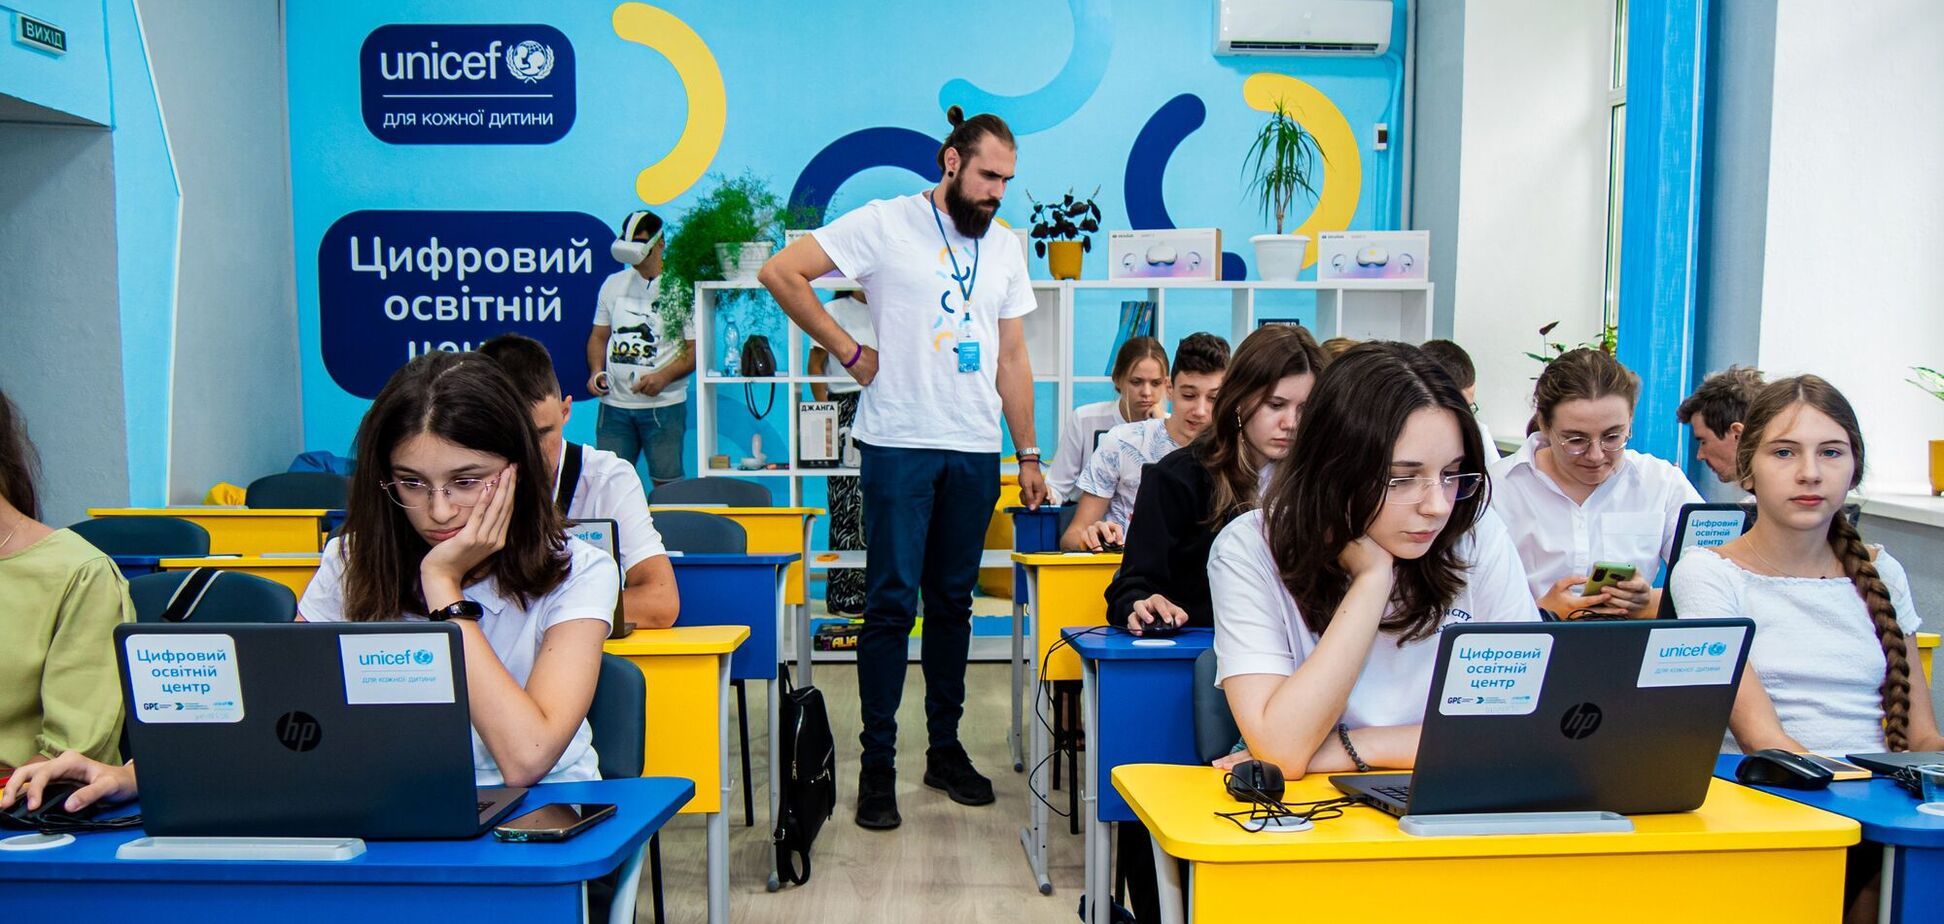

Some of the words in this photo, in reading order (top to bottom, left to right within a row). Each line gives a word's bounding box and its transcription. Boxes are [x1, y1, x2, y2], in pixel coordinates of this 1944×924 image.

[26, 21, 63, 49] ВИХІД
[381, 41, 502, 80] unicef
[383, 112, 416, 128] для
[422, 109, 484, 126] кожної
[489, 112, 554, 128] дитини
[351, 236, 592, 281] Цифровий
[384, 286, 562, 322] освітній
[801, 404, 835, 412] ДЖАНГА
[1692, 519, 1738, 527] Цифровий
[1451, 608, 1472, 621] CITY
[137, 649, 227, 664] Цифровий
[359, 649, 411, 666] unicef
[1459, 647, 1541, 661] Цифровий
[1659, 642, 1709, 658] unicef
[151, 665, 217, 677] освітній
[1466, 662, 1527, 674] освітній
[162, 683, 211, 695] центр
[1470, 680, 1515, 690] центр
[1564, 702, 1600, 740] hp
[283, 708, 316, 752] hp
